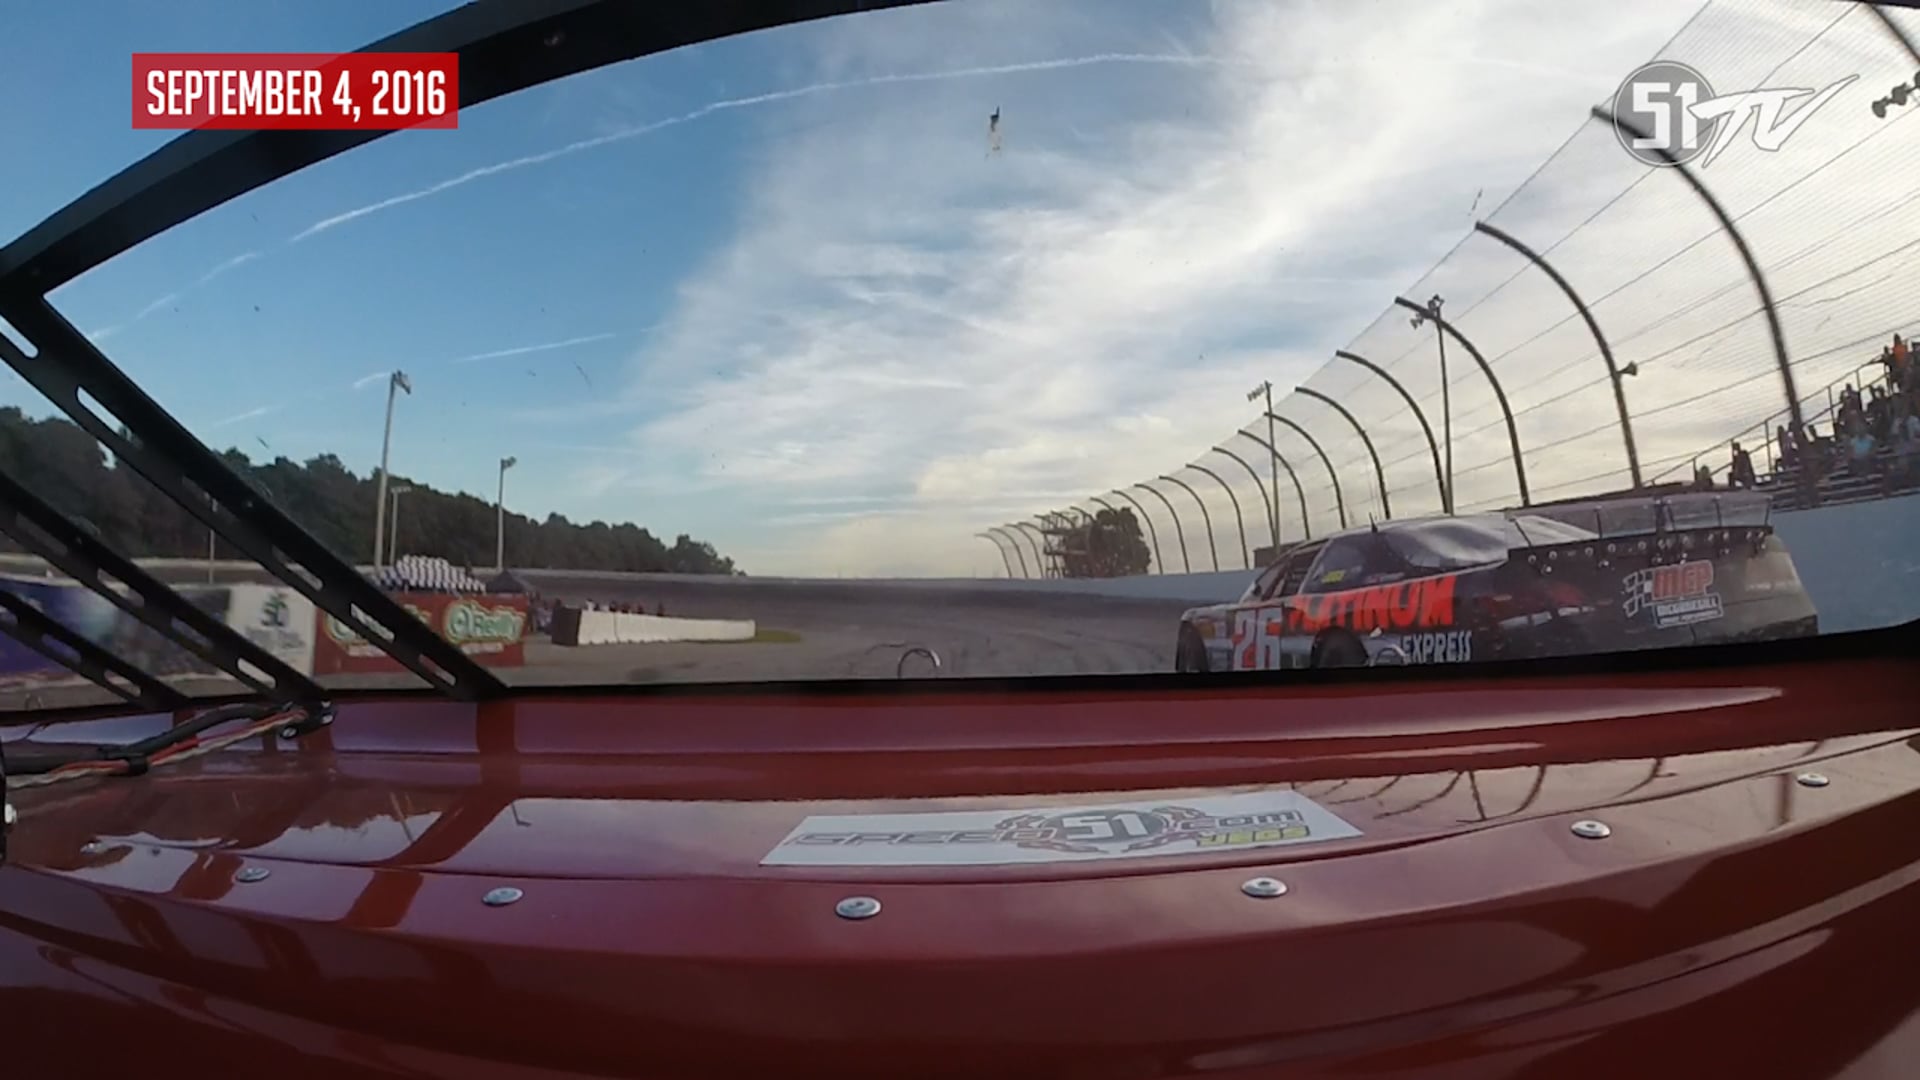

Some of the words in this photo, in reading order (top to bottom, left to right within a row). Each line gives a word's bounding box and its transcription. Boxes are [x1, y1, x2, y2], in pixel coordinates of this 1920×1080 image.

[1231, 607, 1281, 671] 26
[1401, 631, 1472, 664] EXPRESS
[1061, 813, 1147, 840] 51
